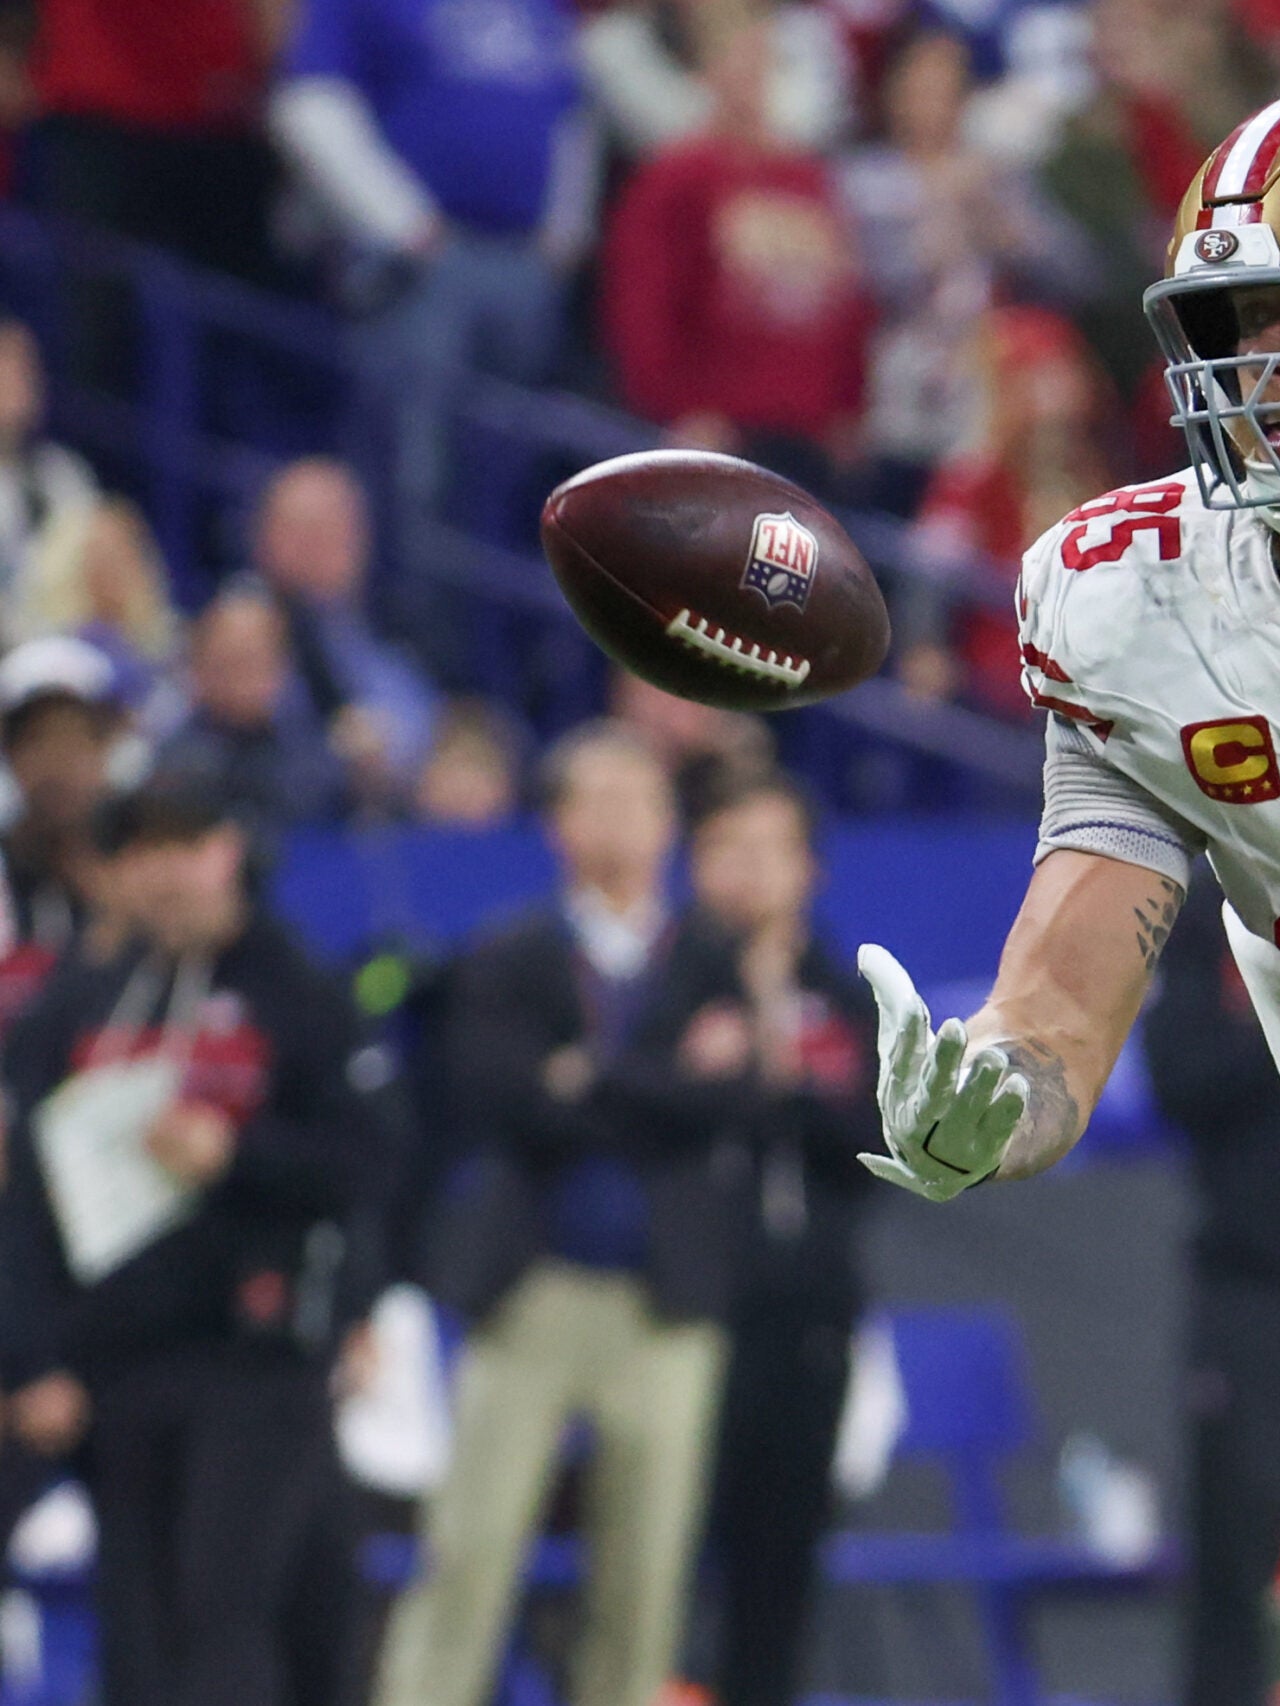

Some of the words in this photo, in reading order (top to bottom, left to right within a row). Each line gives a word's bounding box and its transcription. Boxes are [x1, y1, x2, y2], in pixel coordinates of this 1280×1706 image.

[763, 525, 810, 575] NFL
[1061, 481, 1186, 572] 85
[1190, 723, 1270, 785] C
